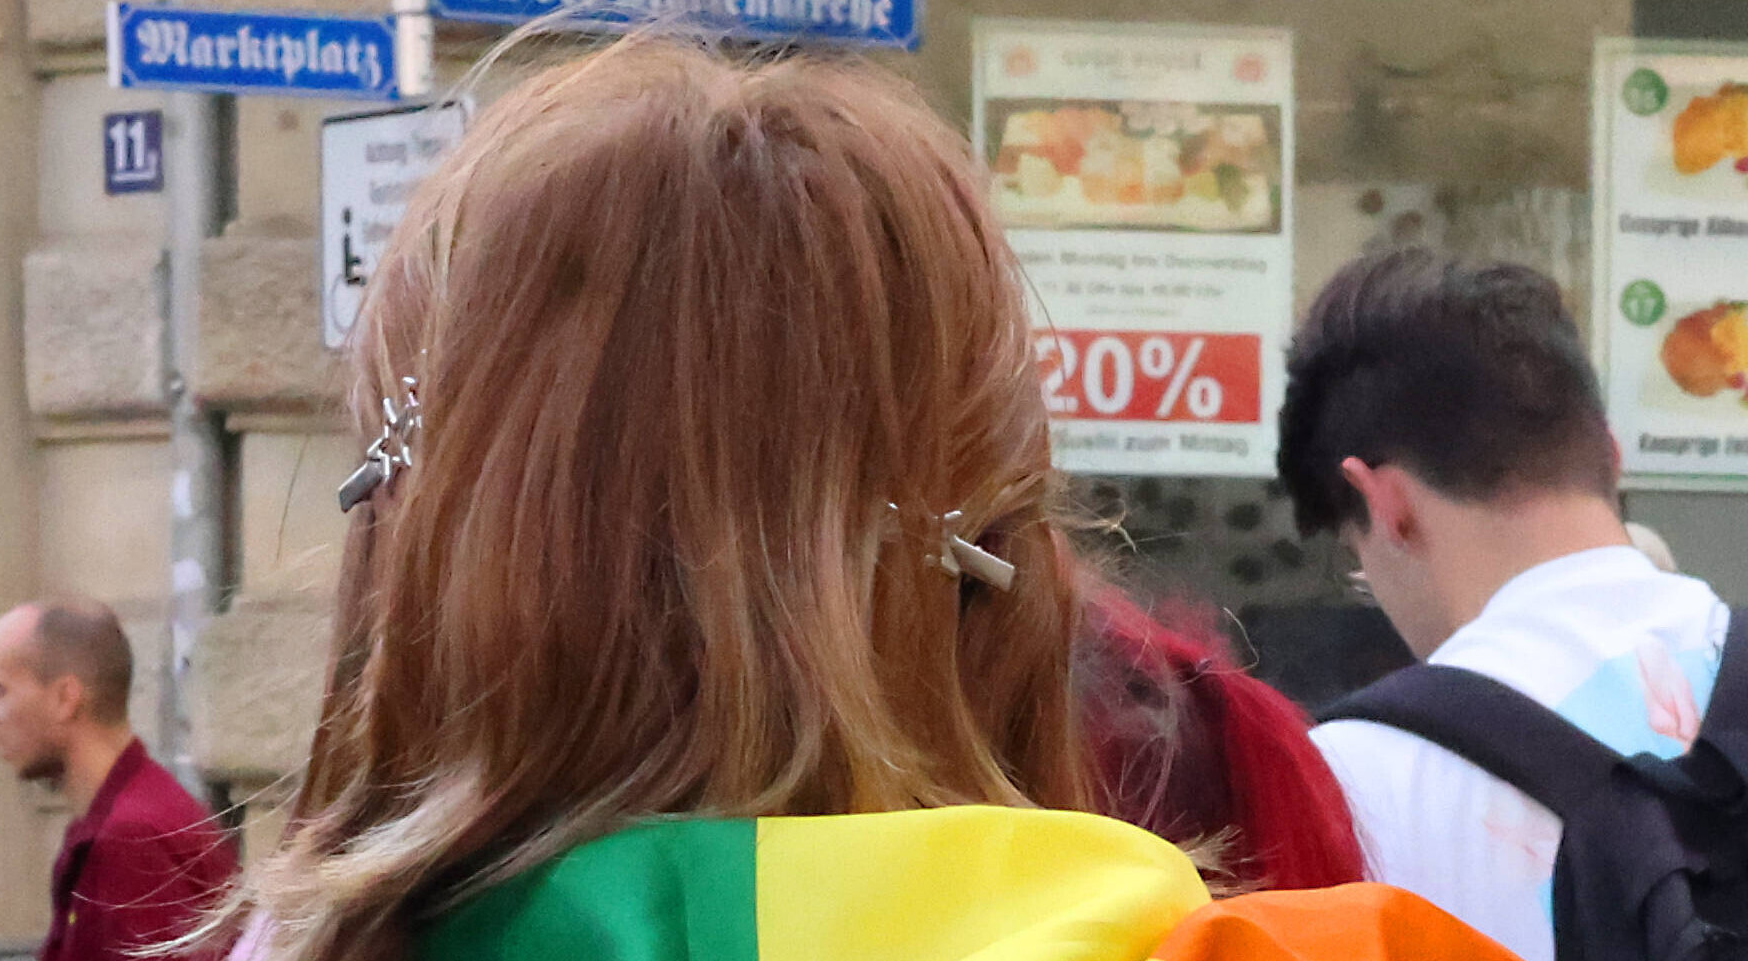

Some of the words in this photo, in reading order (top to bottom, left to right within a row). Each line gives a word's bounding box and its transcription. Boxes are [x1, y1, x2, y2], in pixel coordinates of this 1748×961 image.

[136, 19, 382, 87] Marktplatz
[109, 120, 145, 168] 11
[1034, 336, 1224, 420] 20%
